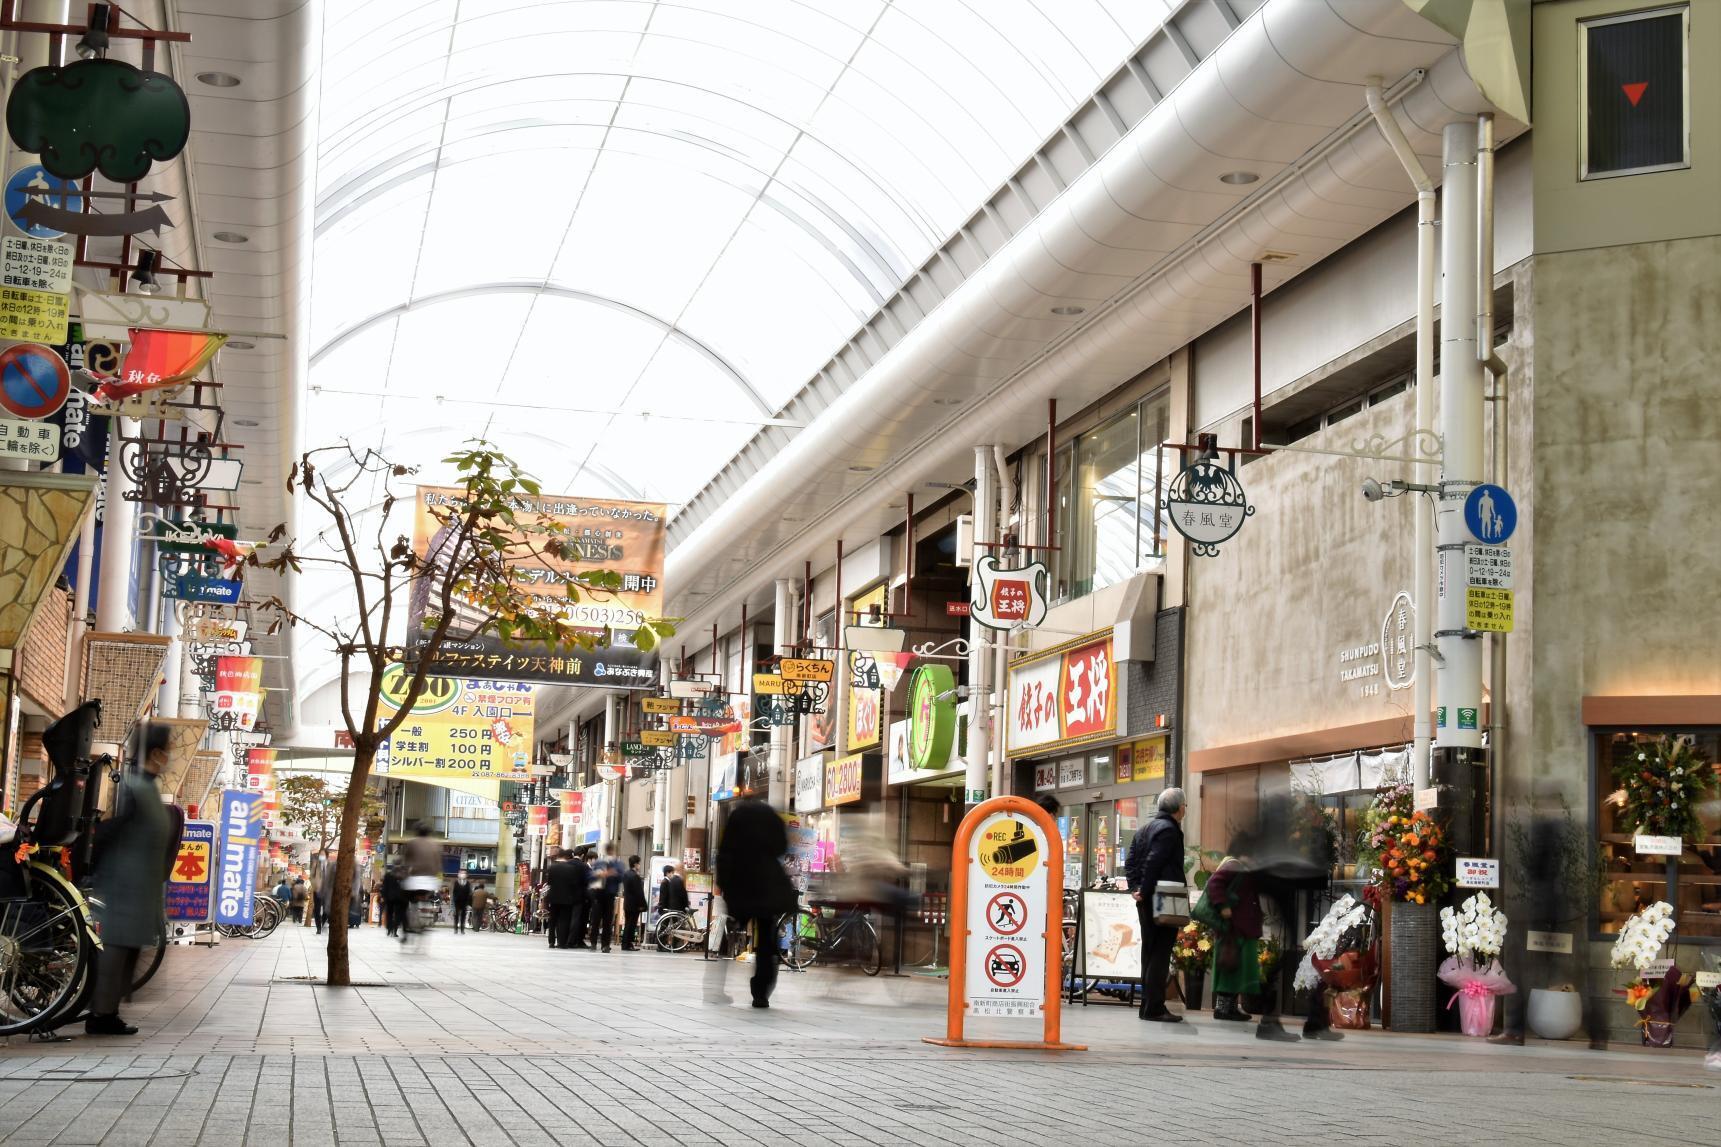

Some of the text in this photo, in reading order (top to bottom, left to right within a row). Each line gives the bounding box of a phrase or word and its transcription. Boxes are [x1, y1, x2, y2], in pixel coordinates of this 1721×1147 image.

[3, 275, 56, 290] 自転車を除く
[1182, 510, 1233, 529] 春風堂
[1468, 577, 1505, 588] 自転車を除く
[1000, 586, 1024, 596] 餃子の
[998, 599, 1026, 614] 王将
[1467, 611, 1512, 622] の間は乗り入れ
[1468, 621, 1506, 631] できません
[1397, 608, 1408, 680] 春風堂
[1340, 644, 1379, 664] SHUNPUDO
[796, 662, 830, 673] らくちん
[1340, 665, 1379, 684] TAKAMATSU
[1067, 650, 1110, 728] 王将
[451, 705, 513, 719] 4F 入園口
[1019, 682, 1056, 734] 餃子の
[400, 726, 423, 738] 一般
[395, 740, 430, 754] 学生割
[391, 755, 446, 769] シルバー割
[991, 831, 1006, 841] REC
[220, 800, 257, 917] animate
[175, 852, 206, 881] 本
[991, 867, 1024, 877] 24時間
